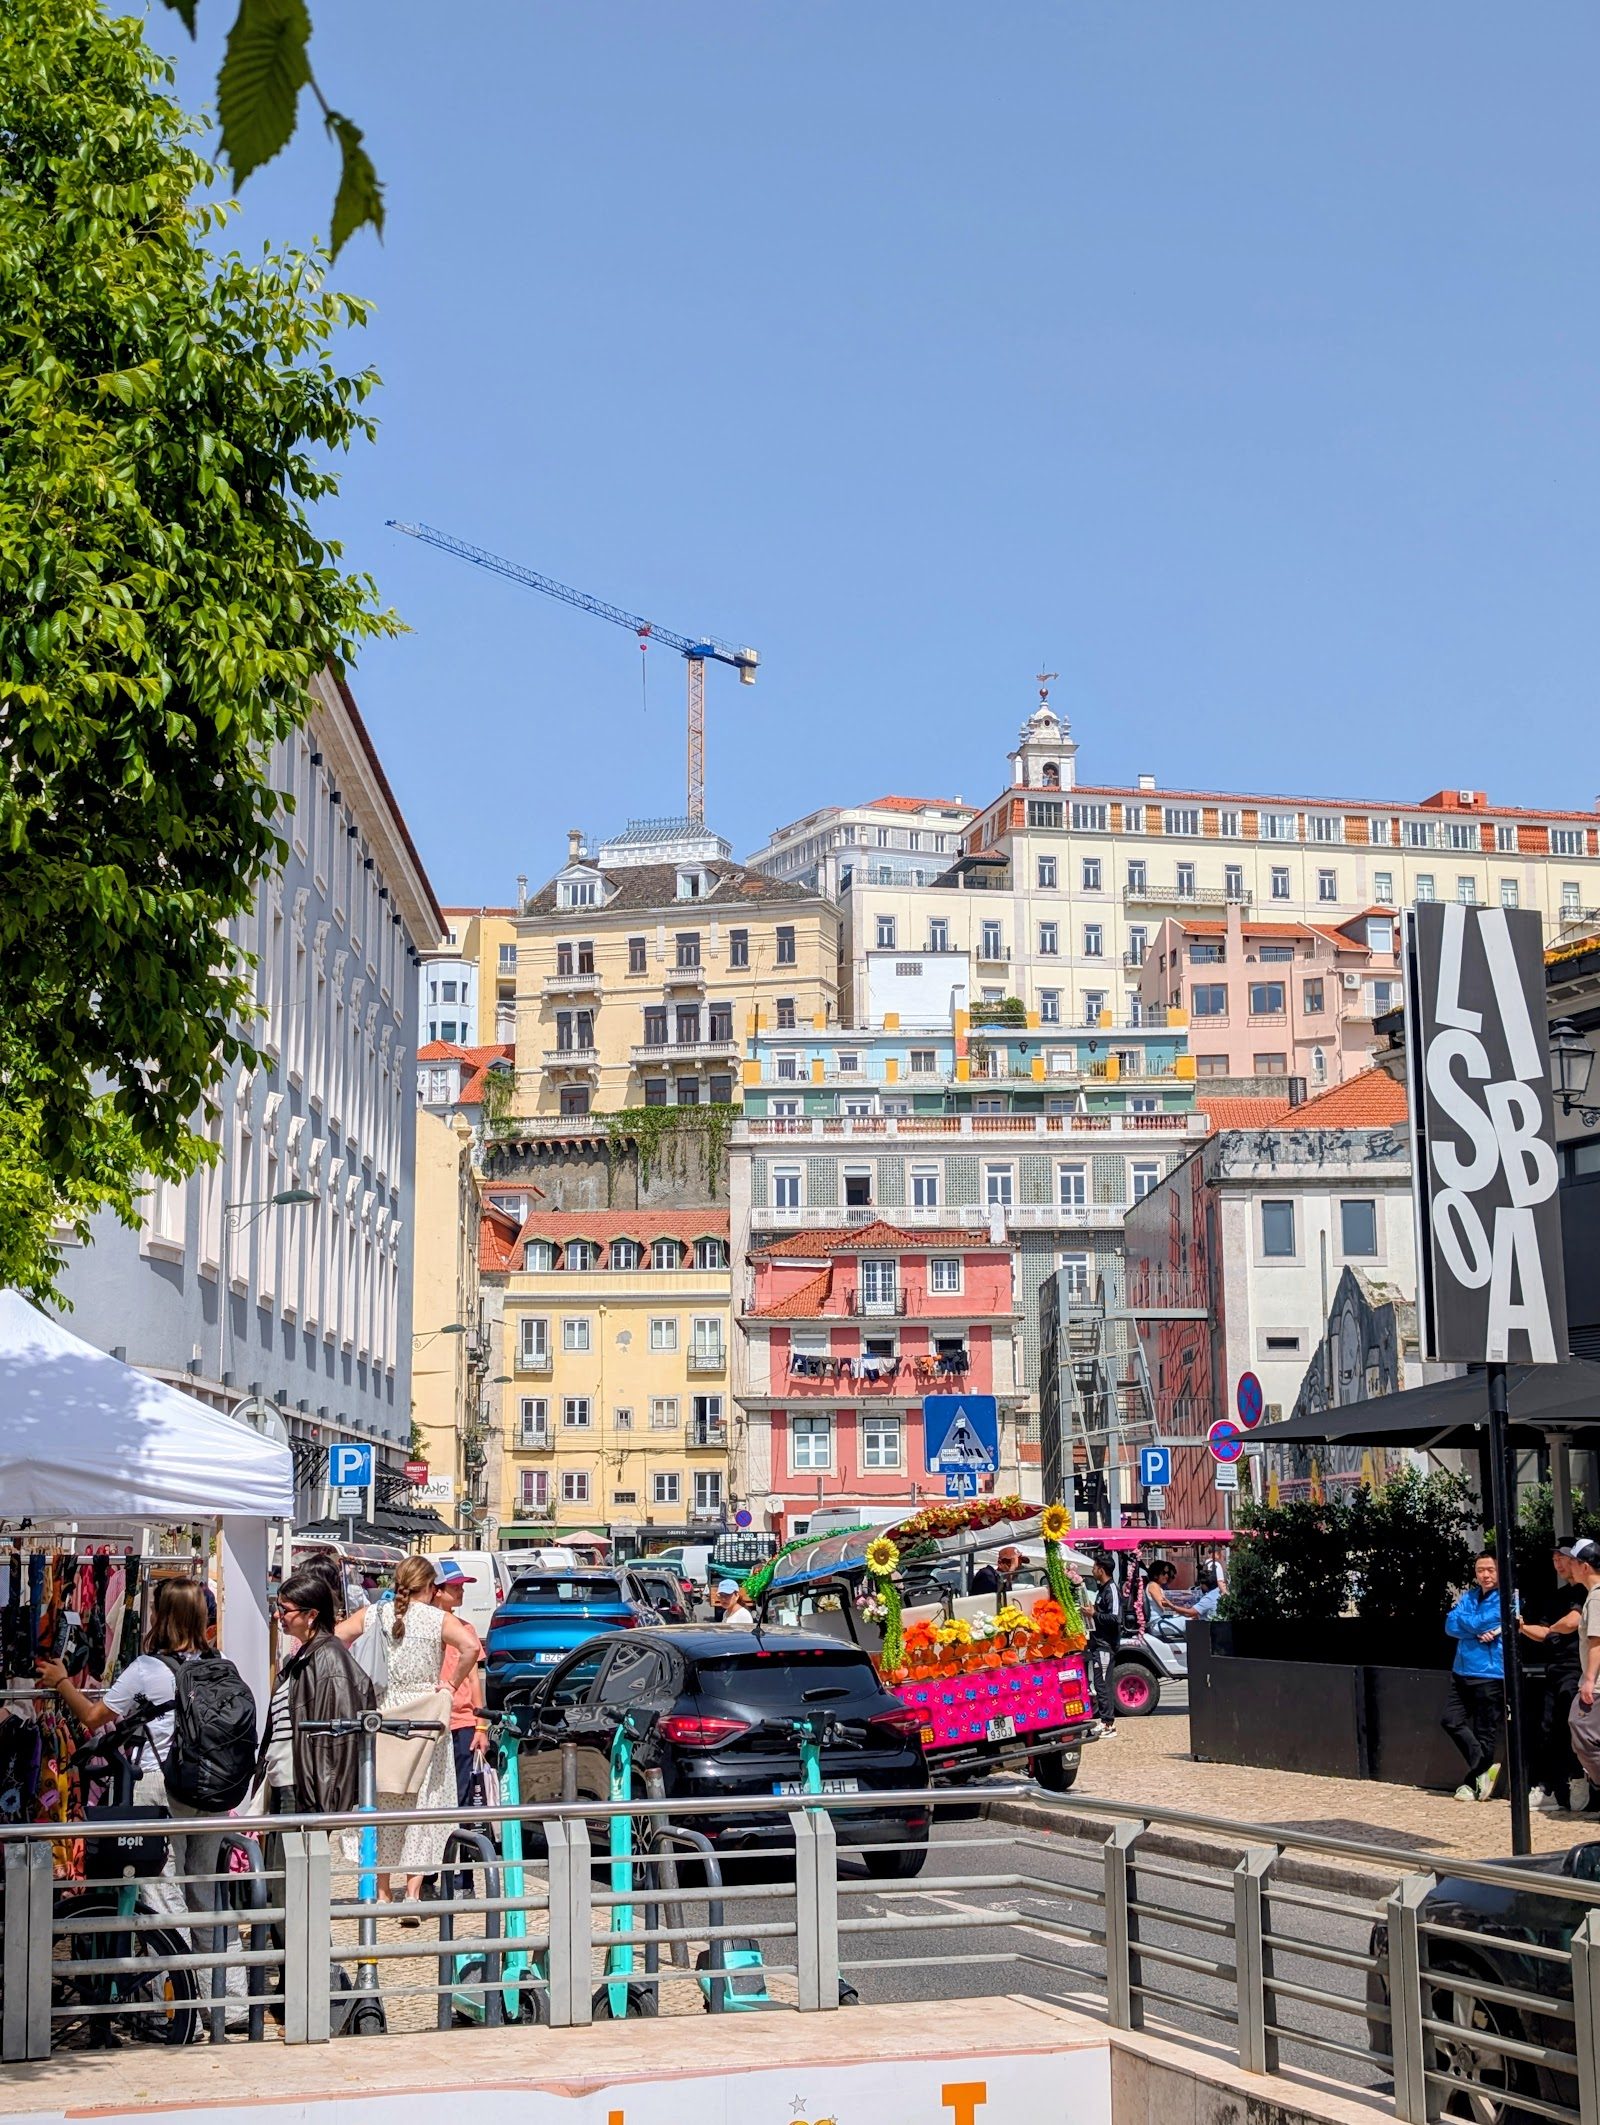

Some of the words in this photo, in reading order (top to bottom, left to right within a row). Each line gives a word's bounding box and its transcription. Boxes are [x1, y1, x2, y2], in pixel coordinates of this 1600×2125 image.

[338, 1448, 363, 1483] P
[1146, 1452, 1164, 1482] P
[117, 1835, 144, 1848] Bolt
